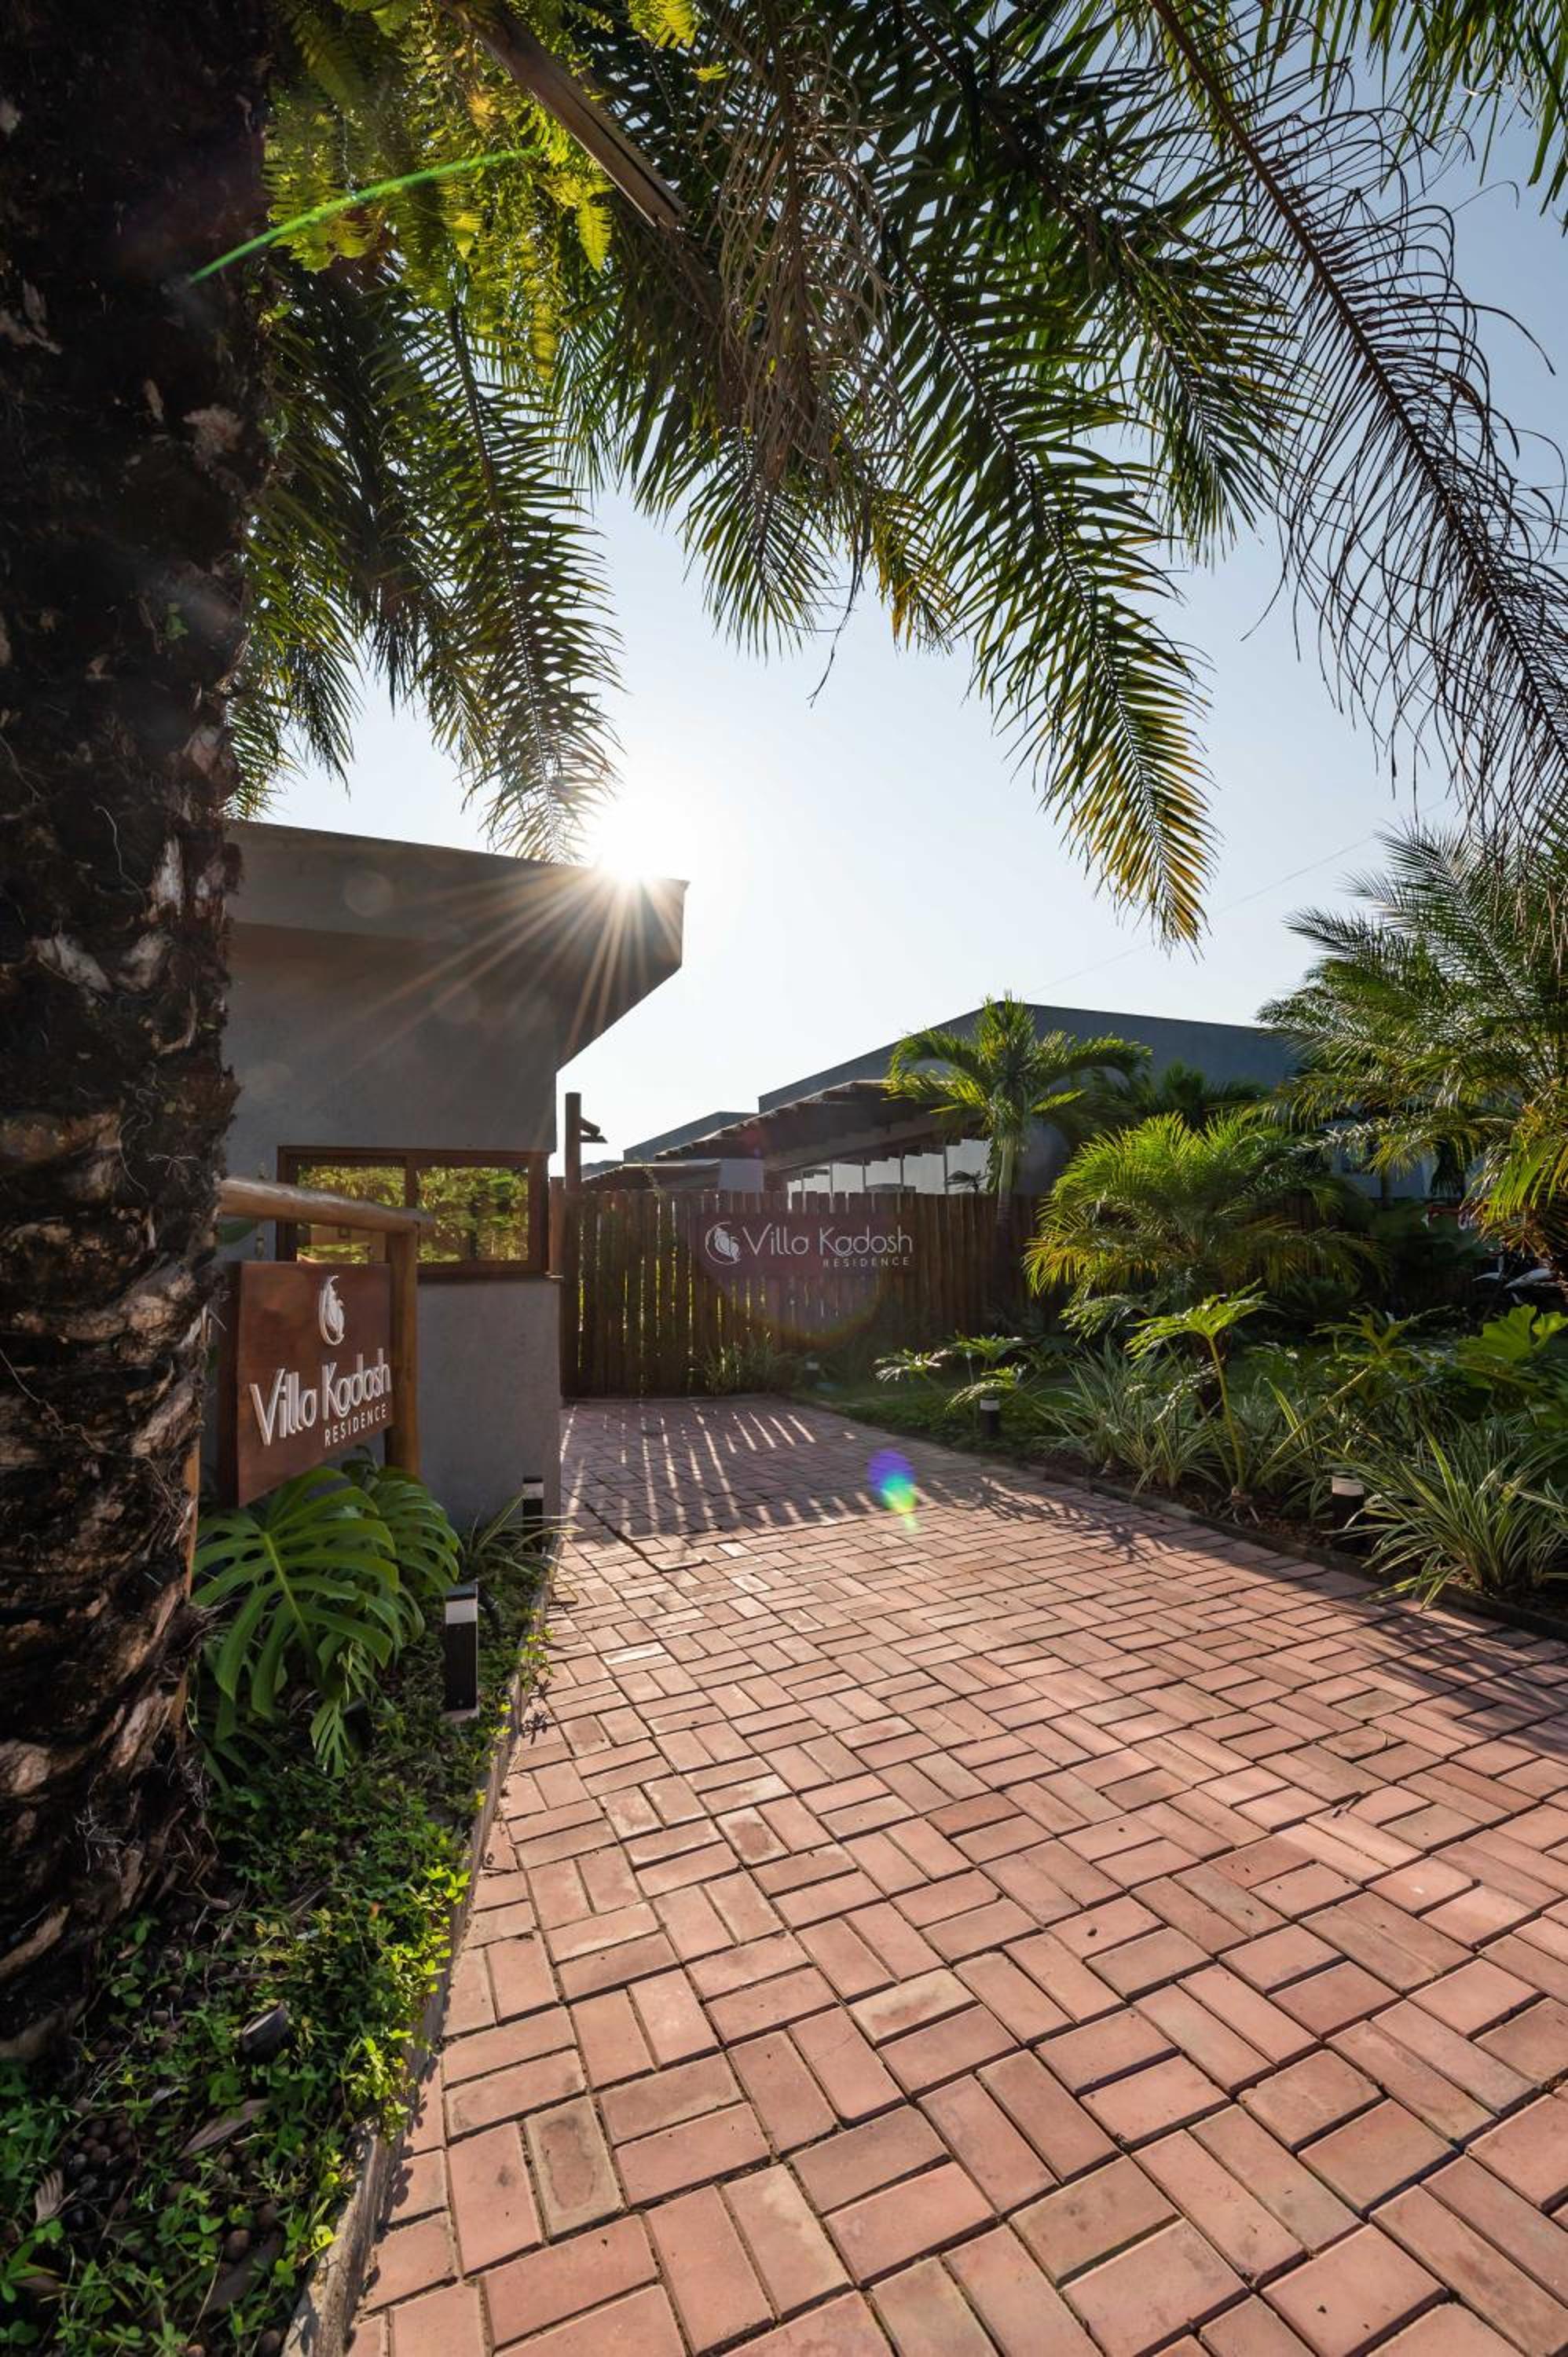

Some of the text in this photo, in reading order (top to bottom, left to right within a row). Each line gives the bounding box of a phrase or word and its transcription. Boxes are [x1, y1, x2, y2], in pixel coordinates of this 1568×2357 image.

[742, 1222, 913, 1257] Villa Kadosh
[822, 1257, 909, 1267] RESIDENCE
[249, 1348, 391, 1446] Villa Kadosh
[324, 1404, 387, 1446] RESIDENCE
